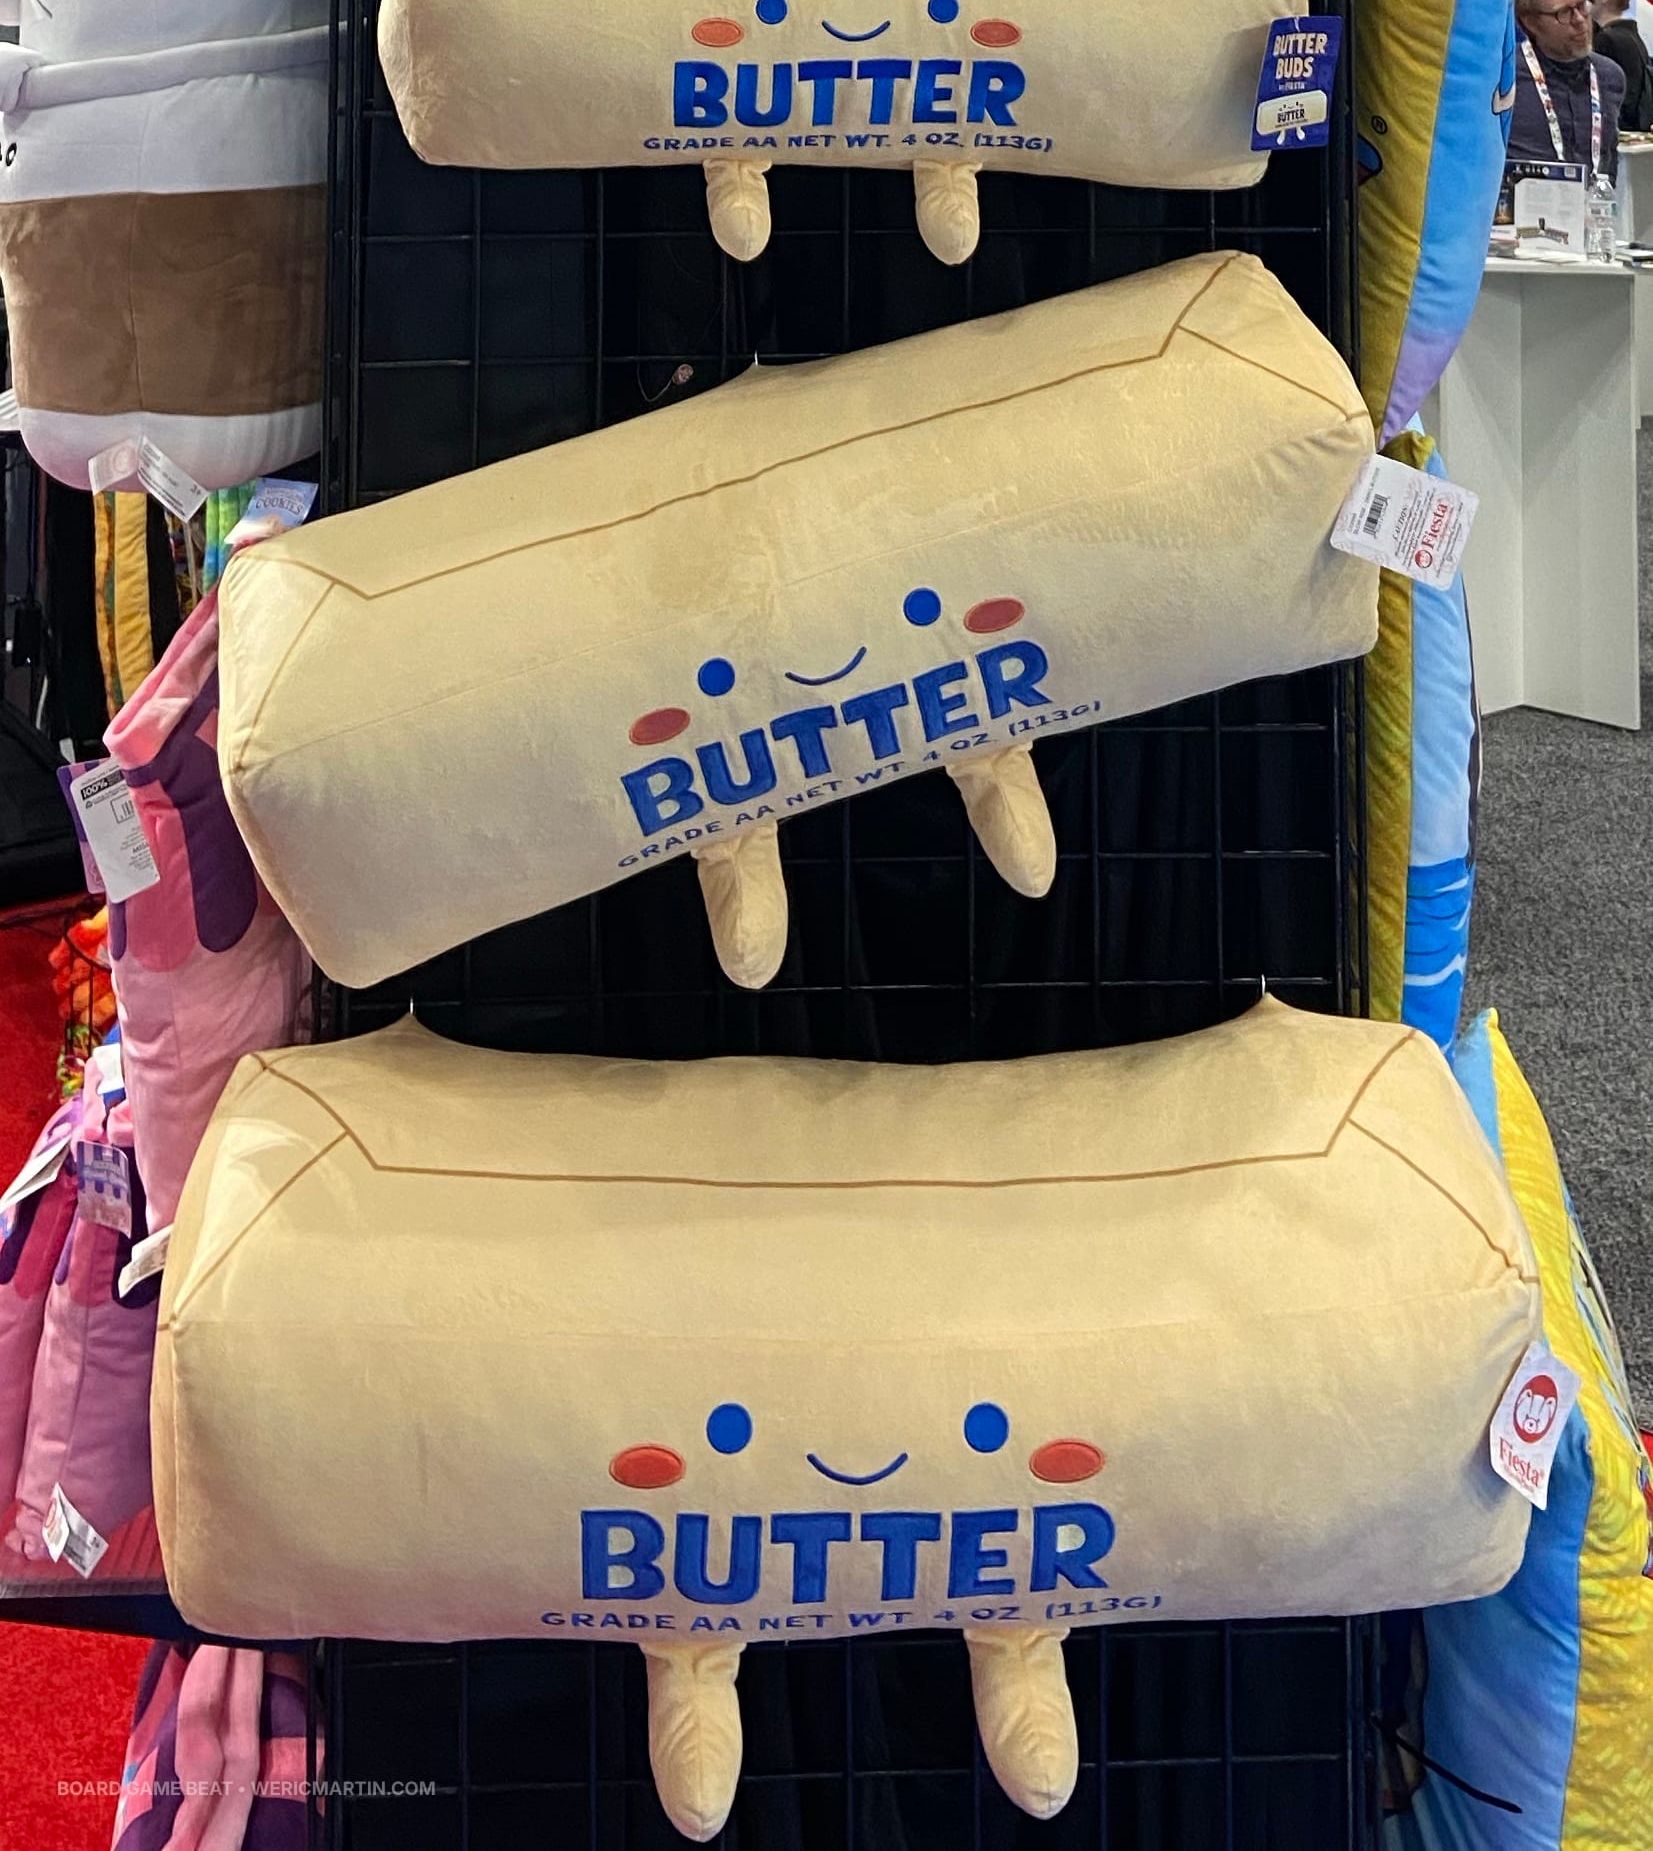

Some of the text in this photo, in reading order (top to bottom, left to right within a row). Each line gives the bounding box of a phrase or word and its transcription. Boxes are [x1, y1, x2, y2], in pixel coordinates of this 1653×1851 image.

[1273, 33, 1329, 56] BUTTER
[1275, 56, 1315, 79] BUDS
[674, 58, 1026, 128] BUTTER
[643, 137, 735, 150] GRADE
[742, 136, 778, 147] AA
[788, 135, 836, 148] NET
[902, 134, 917, 145] 4
[974, 133, 1053, 152] (113G)
[621, 640, 1053, 837] BUTTER
[618, 821, 724, 867] GRADE
[735, 805, 775, 825] AA
[786, 780, 843, 806] NET
[923, 750, 941, 762] 4
[1500, 1437, 1541, 1487] Fiesta
[580, 1502, 1116, 1605] BUTTER
[541, 1612, 676, 1630] GRADE
[690, 1615, 742, 1631] AA
[759, 1614, 833, 1630] NET
[933, 1609, 956, 1621] 4
[1046, 1595, 1162, 1620] (113G)
